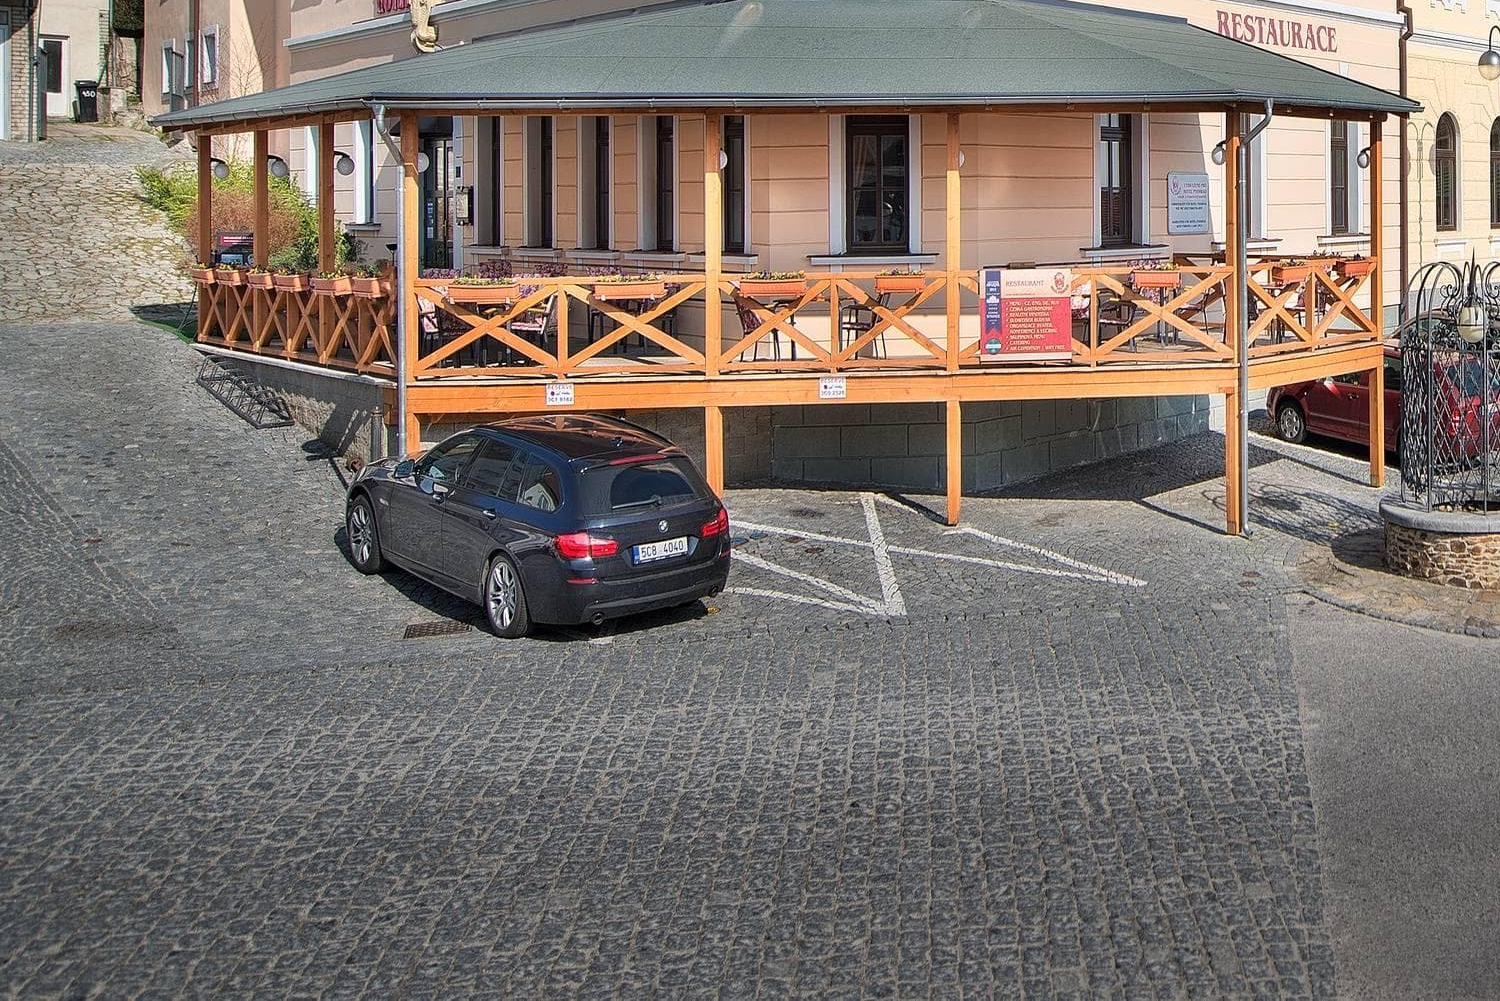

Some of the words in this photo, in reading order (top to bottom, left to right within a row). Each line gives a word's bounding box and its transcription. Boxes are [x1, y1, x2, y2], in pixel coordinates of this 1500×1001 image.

[1216, 10, 1338, 53] RESTAURACE
[1006, 280, 1045, 288] RESTAURANT
[641, 545, 657, 558] 5C8
[663, 540, 684, 553] 4040
